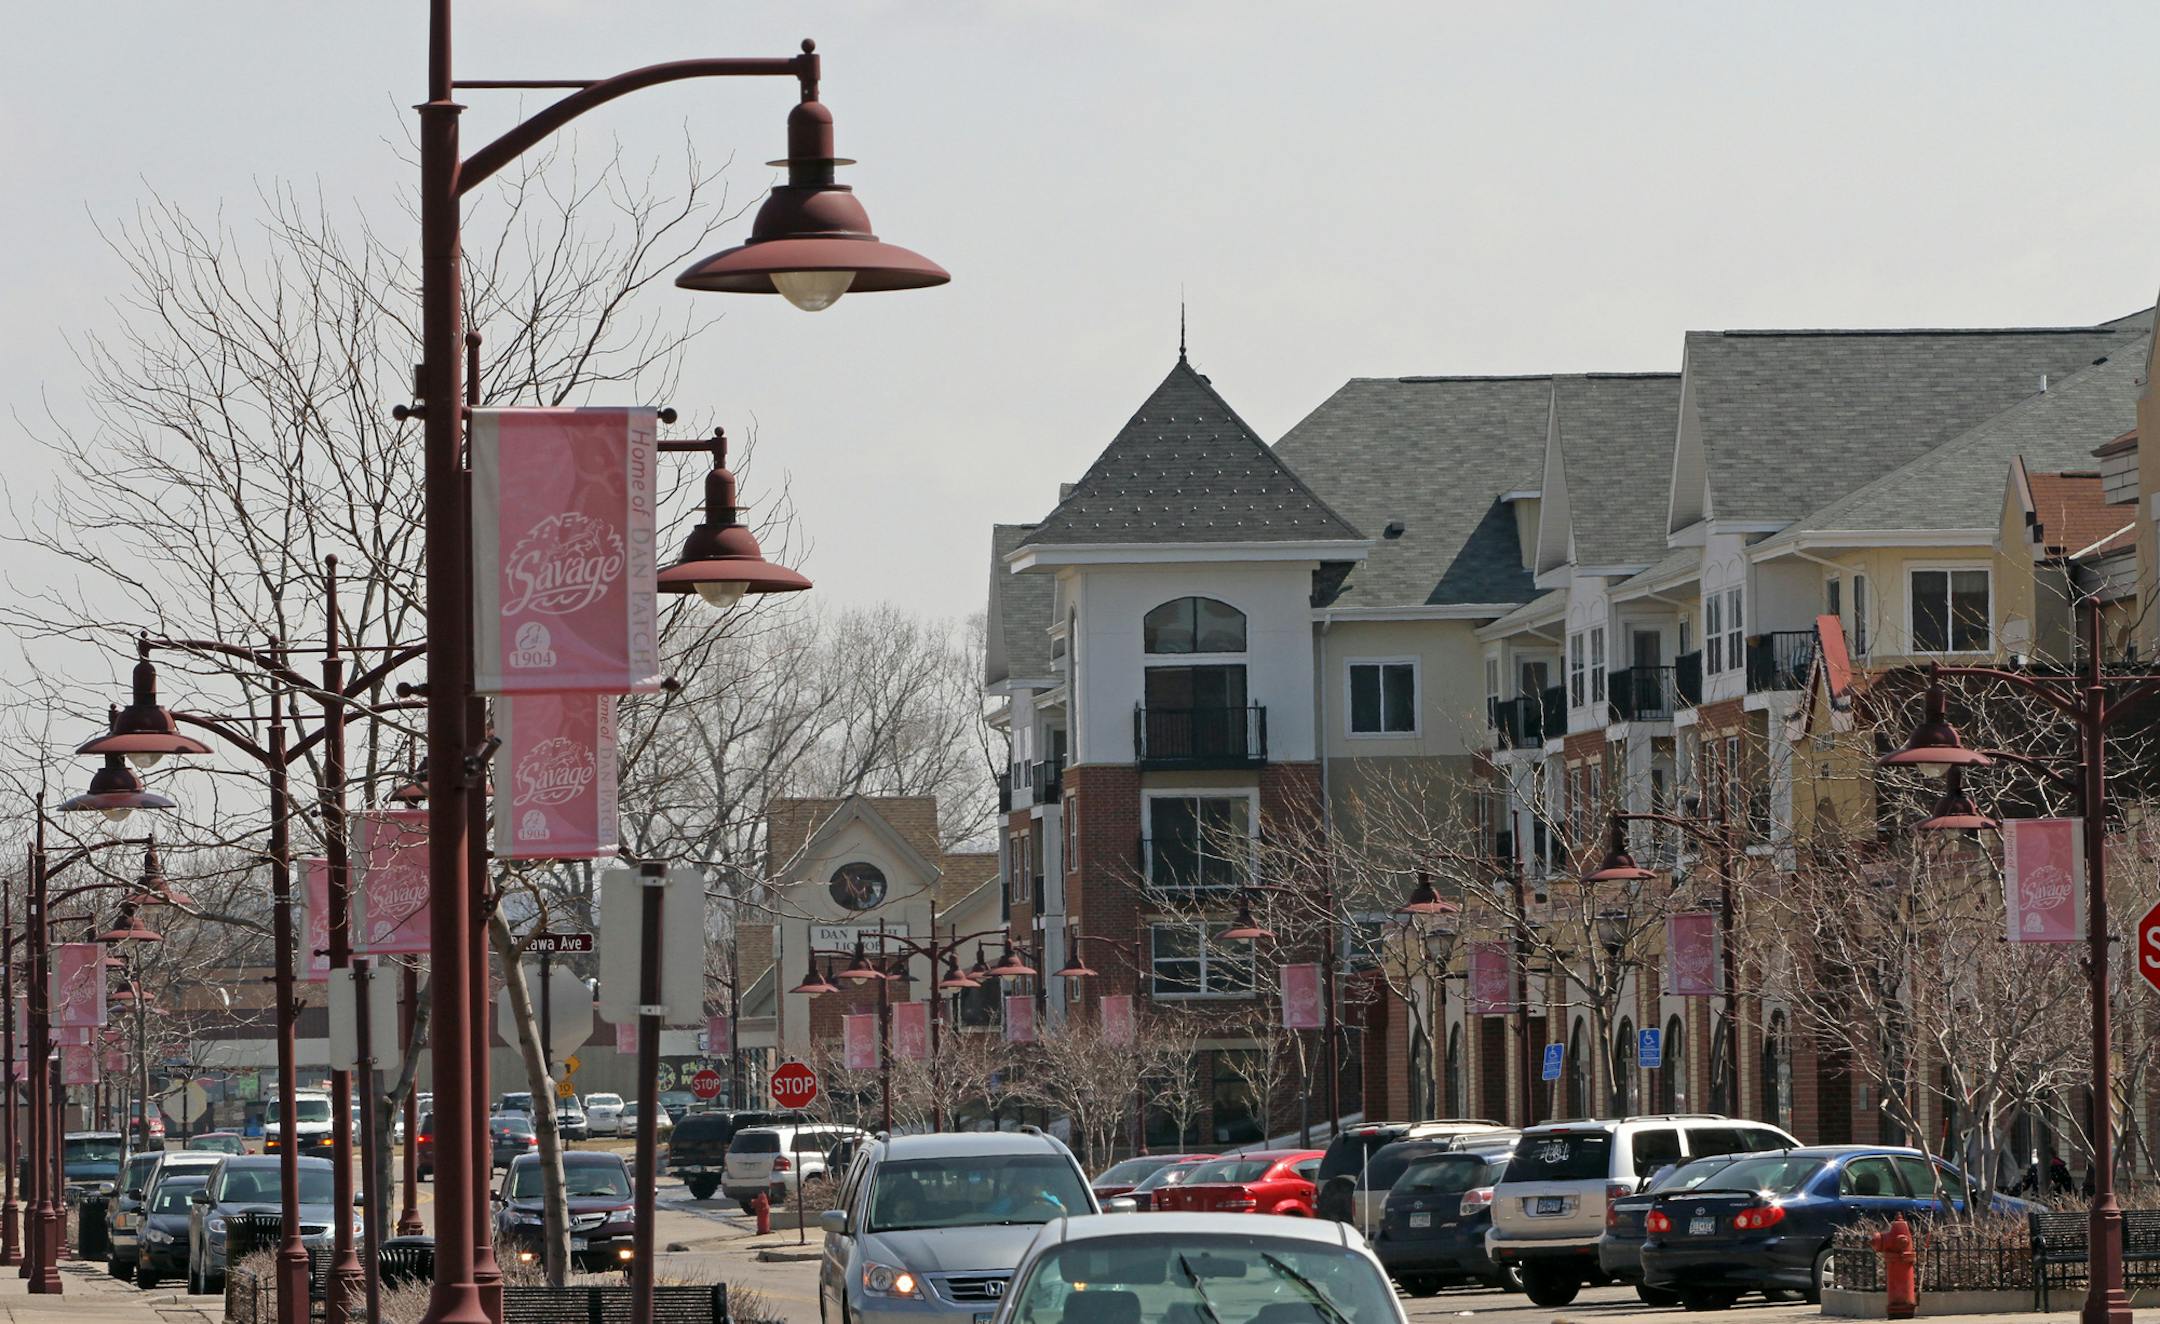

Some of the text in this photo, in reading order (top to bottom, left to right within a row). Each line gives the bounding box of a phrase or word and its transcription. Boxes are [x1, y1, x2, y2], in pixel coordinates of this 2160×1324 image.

[631, 429, 652, 669] Home of DAN PATCH
[502, 549, 624, 616] Savage
[512, 651, 553, 667] 1904
[600, 696, 609, 723] ome
[600, 726, 613, 742] of
[514, 761, 596, 806] Savage
[368, 883, 430, 918] Savage
[2021, 880, 2073, 911] Savage
[560, 936, 582, 950] Ave
[821, 929, 848, 939] DAN
[694, 1078, 720, 1090] STOP
[774, 1077, 814, 1095] STOP
